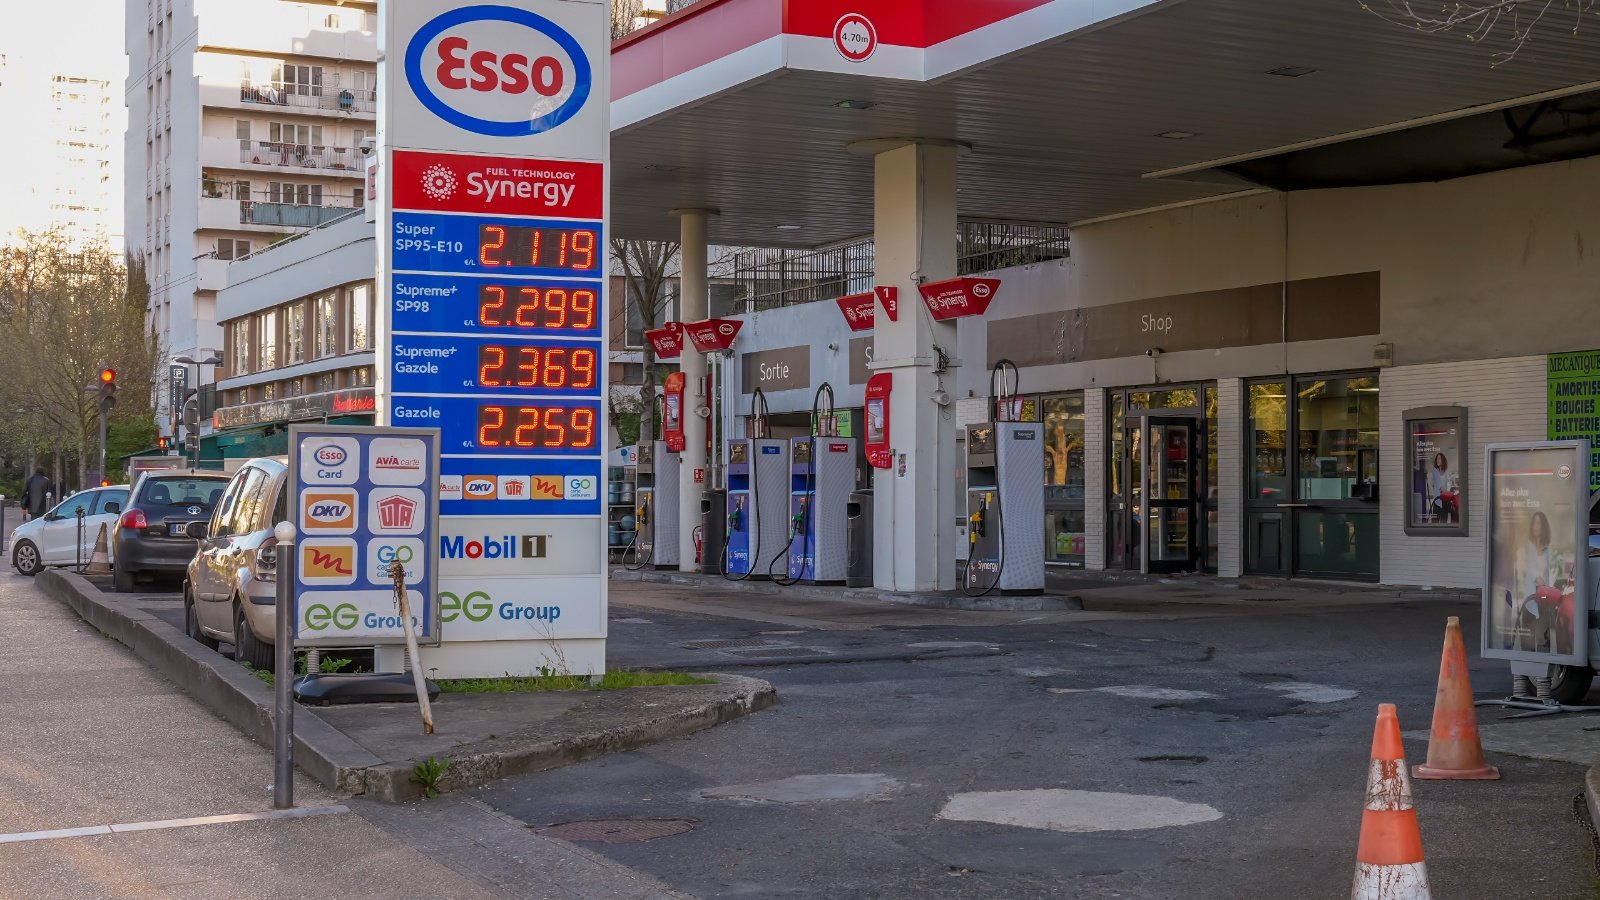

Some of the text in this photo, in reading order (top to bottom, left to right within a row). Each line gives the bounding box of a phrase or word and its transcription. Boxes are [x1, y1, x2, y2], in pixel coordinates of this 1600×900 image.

[486, 167, 576, 180] FUEL TECHNOLOGY
[466, 172, 576, 207] Synergy
[395, 222, 436, 237] Super
[395, 239, 463, 253] SP95-E10
[480, 226, 594, 270] 2.119
[883, 287, 889, 298] 1
[395, 300, 430, 313] SP98
[480, 286, 594, 328] 2.299
[889, 300, 897, 311] 3
[937, 295, 969, 310] Synergy
[670, 323, 677, 331] 5
[1141, 313, 1173, 335] Shop
[676, 333, 682, 342] 7
[394, 362, 439, 374] Gazole
[480, 347, 594, 388] 2.369
[760, 362, 789, 381] Sortie
[394, 406, 441, 418] Gazole
[1555, 399, 1595, 414] BOUGIES
[479, 407, 593, 447] 2.259
[400, 458, 420, 466] carte
[317, 469, 342, 479] Card
[468, 483, 492, 492] DKV
[504, 479, 523, 496] UTA
[570, 478, 591, 489] GO
[312, 505, 347, 517] DKV
[380, 497, 414, 527] UTA
[377, 545, 414, 563] GO
[440, 535, 516, 559] Mobil
[977, 560, 999, 573] Synergy
[498, 602, 561, 623] Group
